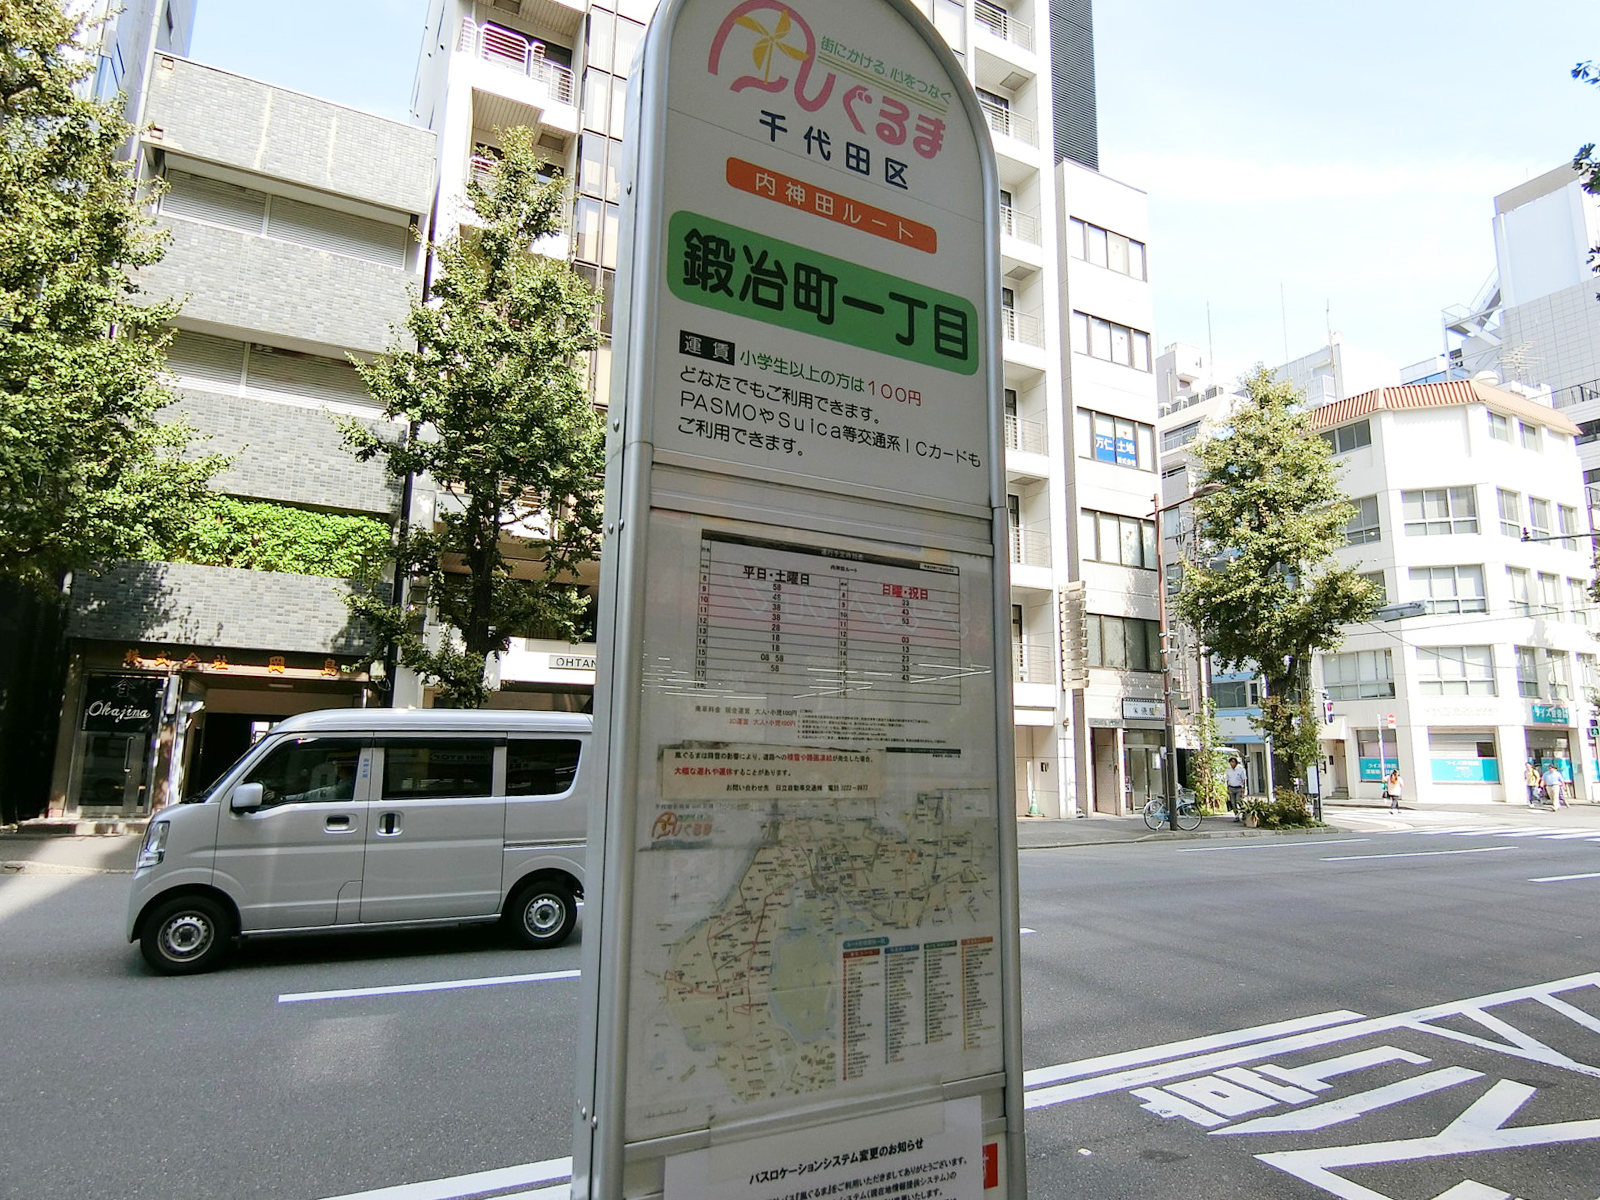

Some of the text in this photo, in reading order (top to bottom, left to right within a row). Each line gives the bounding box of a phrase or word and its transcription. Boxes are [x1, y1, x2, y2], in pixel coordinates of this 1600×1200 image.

[759, 109, 908, 191] 千代田区
[755, 172, 914, 241] 内神田ルート
[683, 228, 968, 361] 鍛冶町一丁目
[684, 335, 730, 363] 運賃
[680, 366, 881, 425] どなたでもご利用できます。
[678, 416, 804, 457] ご利用できます。
[743, 565, 810, 586] 平日・土曜日
[882, 582, 929, 601] 日曜・祝日
[749, 1137, 924, 1185] バスロケーションシステム変更のお知らせ
